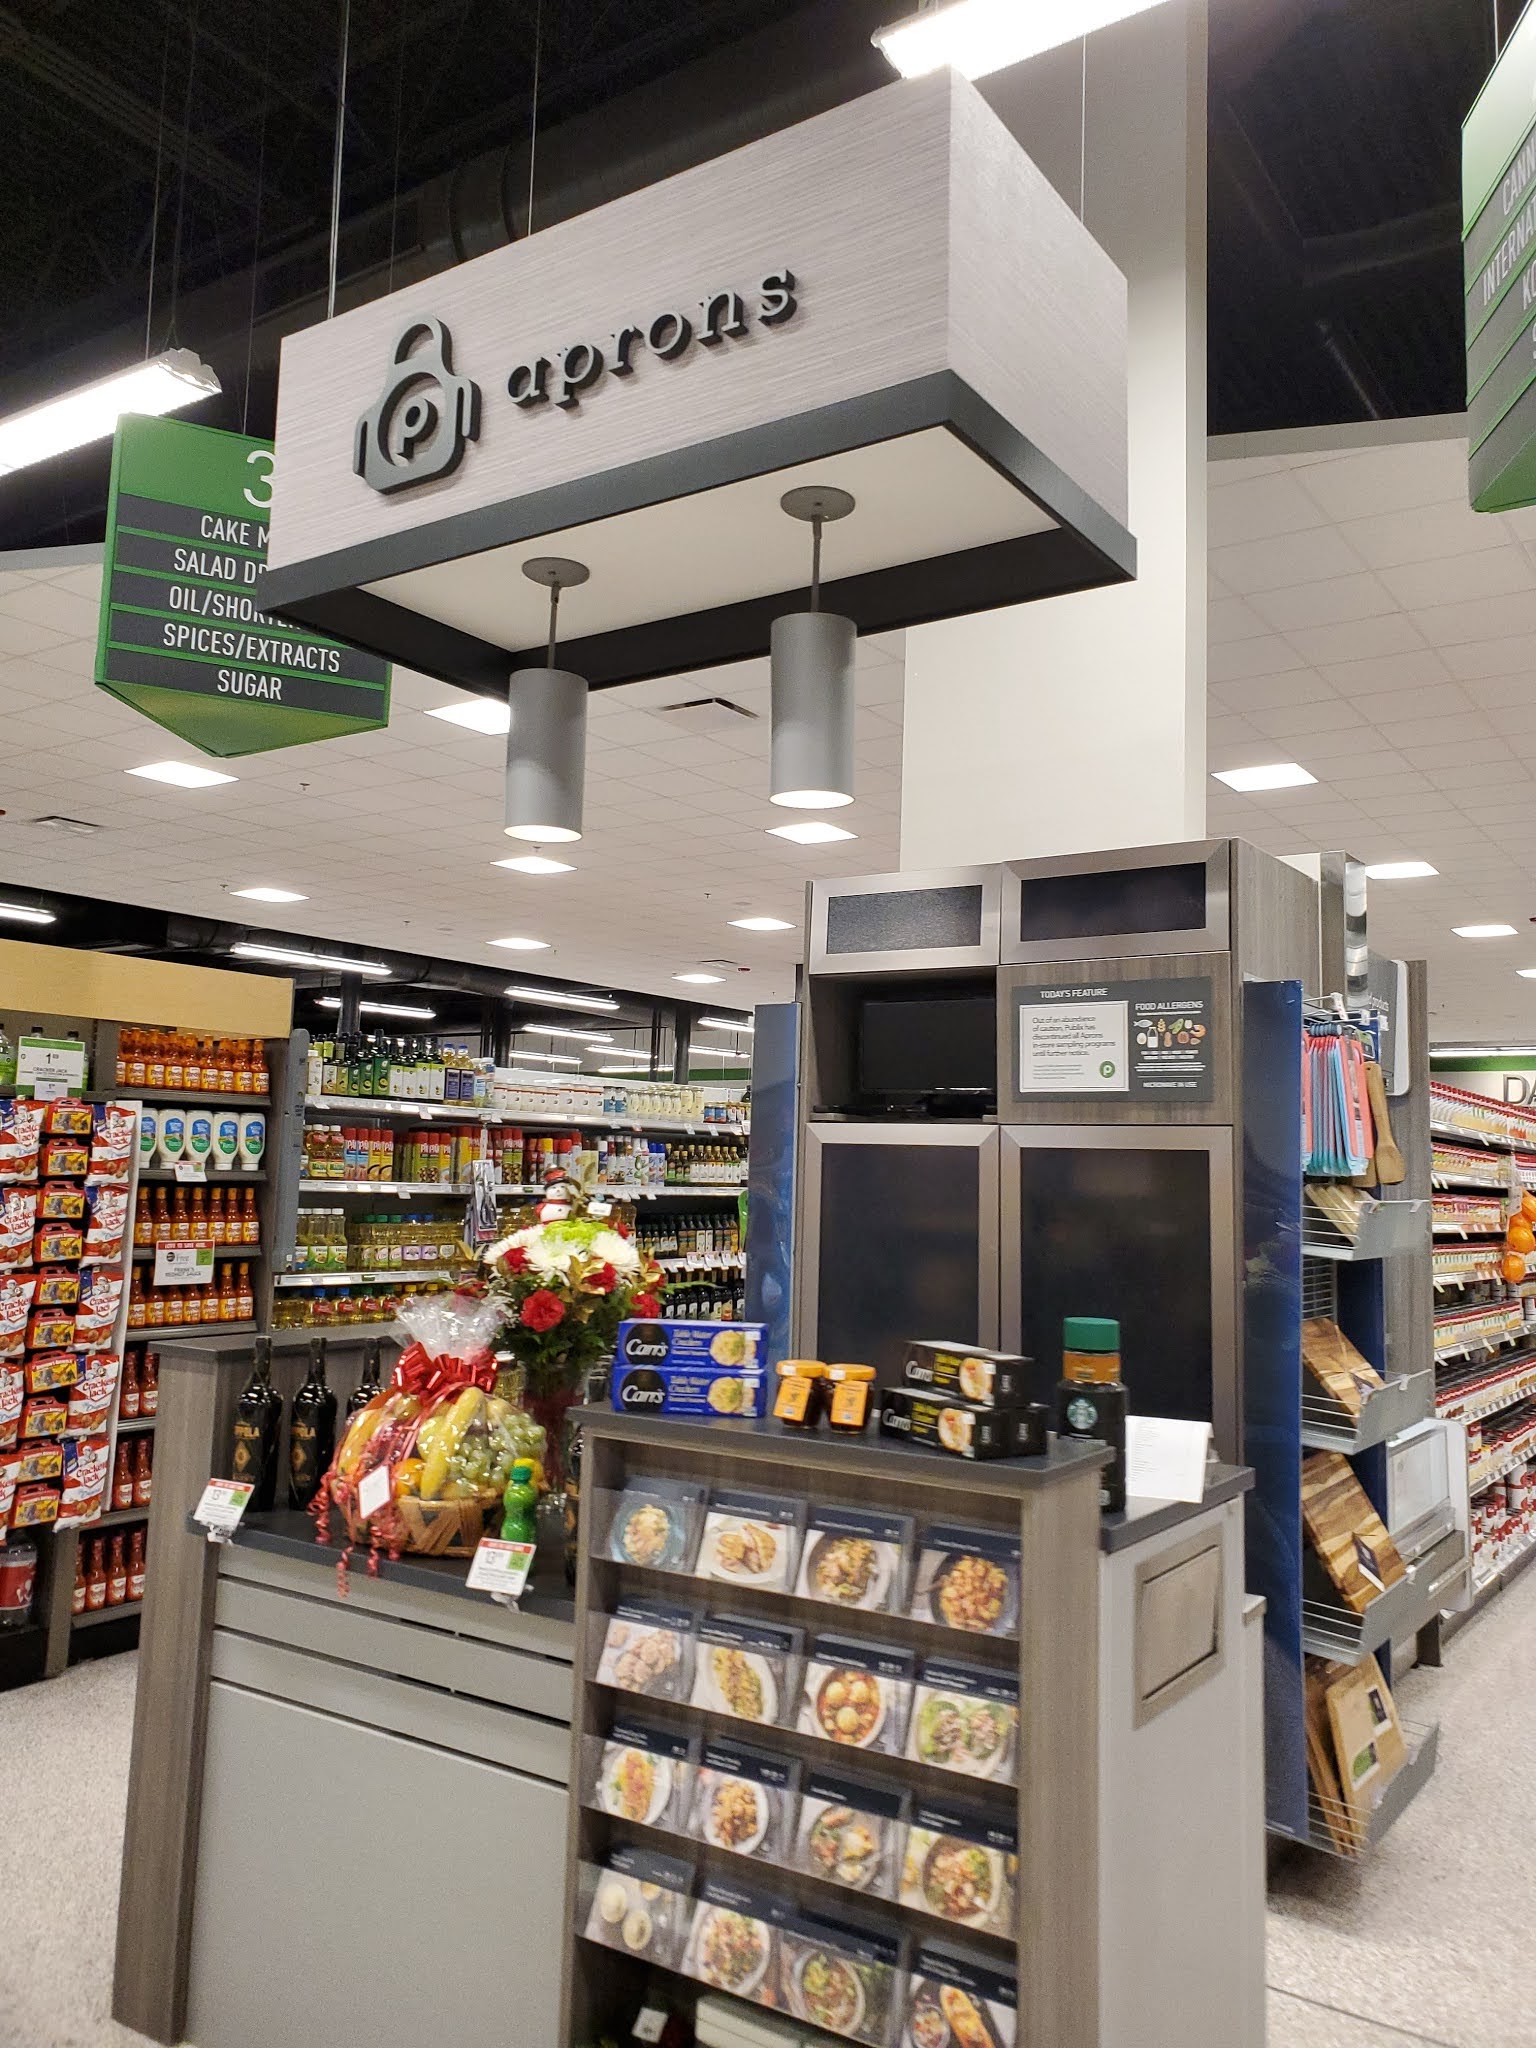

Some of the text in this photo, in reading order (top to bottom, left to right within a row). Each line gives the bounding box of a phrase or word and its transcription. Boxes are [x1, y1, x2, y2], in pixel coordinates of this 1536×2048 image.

[507, 269, 798, 408] aprons
[243, 450, 276, 508] 3
[201, 515, 251, 545] CAKE
[174, 549, 236, 583] SALAD
[163, 623, 341, 673] SPICES/EXTRACTS
[217, 670, 282, 700] SUGAR
[1072, 988, 1108, 996] FEATURE
[1135, 1001, 1204, 1011] FOOD ALLERGENS
